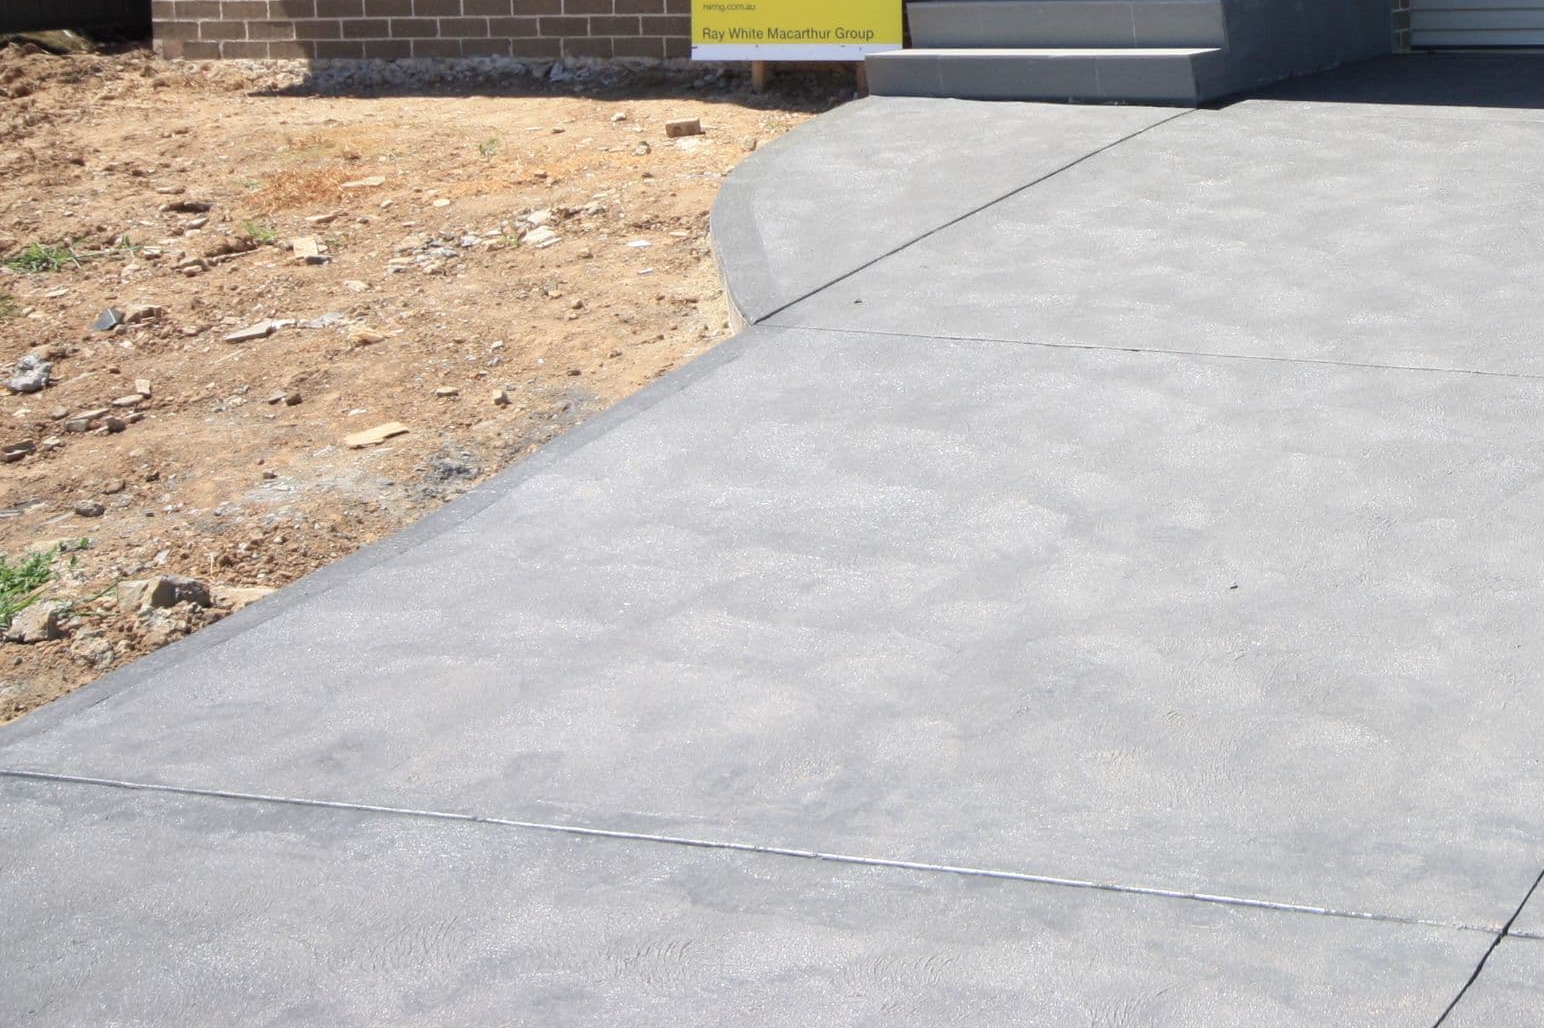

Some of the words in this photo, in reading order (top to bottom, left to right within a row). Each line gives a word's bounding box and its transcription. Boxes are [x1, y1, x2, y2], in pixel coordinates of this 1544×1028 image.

[702, 28, 725, 42] Ray
[729, 28, 763, 39] White
[768, 28, 831, 39] Macarthur
[835, 27, 874, 42] Group
